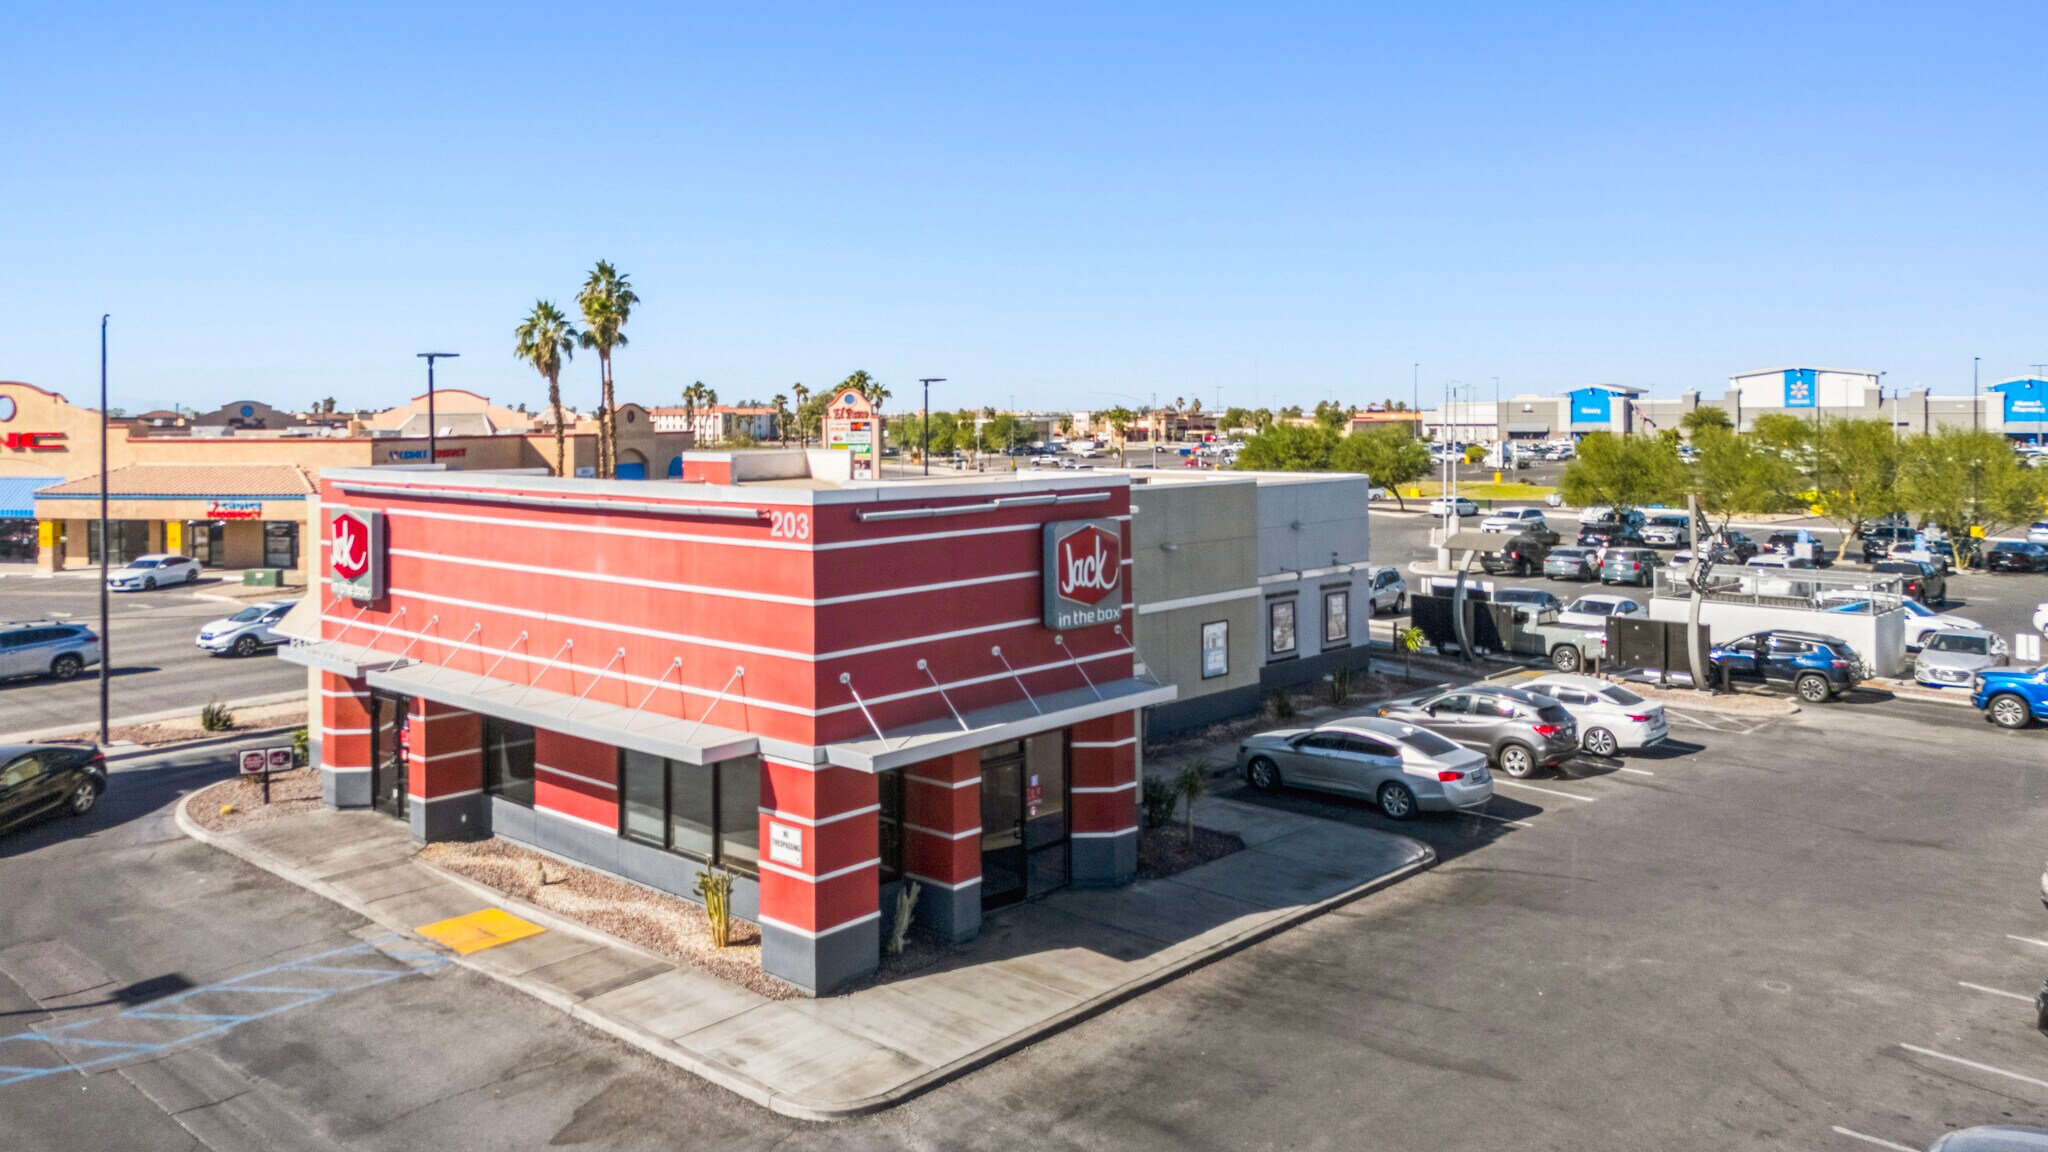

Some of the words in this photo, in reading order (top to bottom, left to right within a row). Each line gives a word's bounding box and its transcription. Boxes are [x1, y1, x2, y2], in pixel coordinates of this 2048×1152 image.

[770, 511, 809, 540] 203
[1062, 535, 1118, 593] Jack
[1058, 612, 1071, 627] in
[1073, 610, 1095, 625] the
[1097, 607, 1120, 622] box
